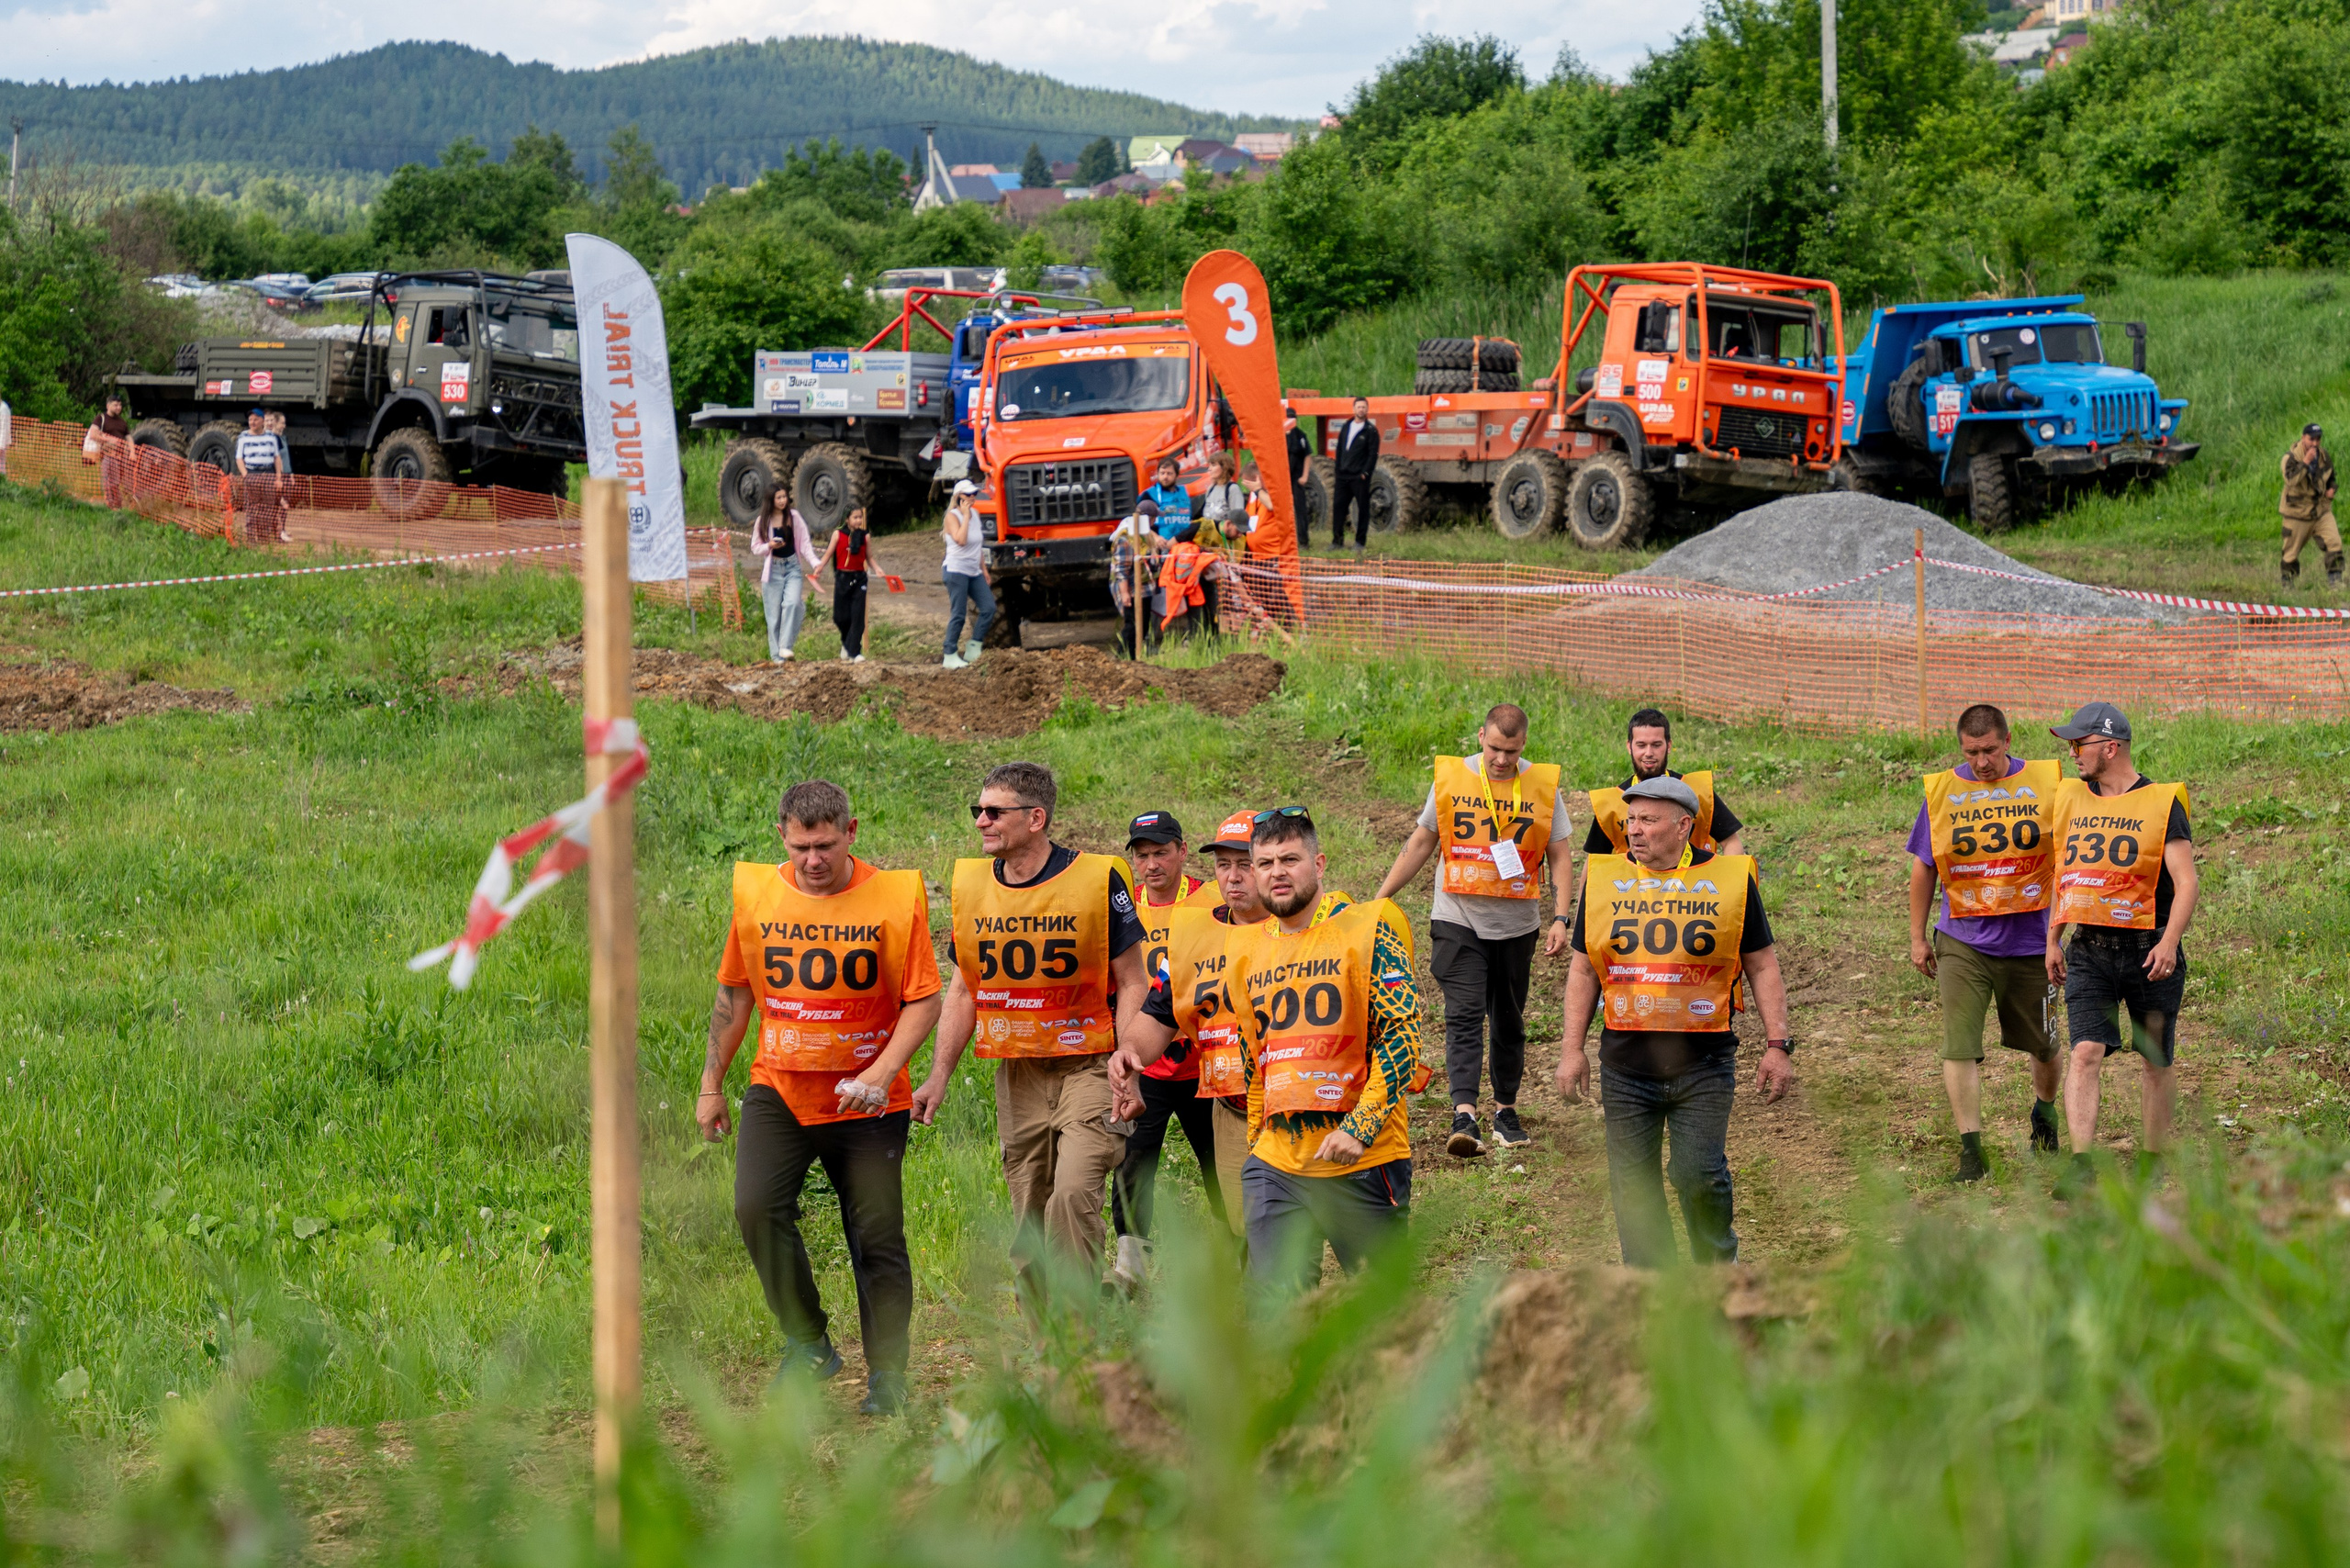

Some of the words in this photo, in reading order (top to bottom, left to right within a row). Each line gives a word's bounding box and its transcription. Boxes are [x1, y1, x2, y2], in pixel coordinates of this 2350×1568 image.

[1213, 282, 1258, 346] 3
[443, 384, 465, 398] 530
[1639, 384, 1662, 400] 500
[1732, 384, 1806, 404] УРАЛ
[1639, 402, 1674, 413] URAL
[1939, 413, 1958, 431] 517
[1039, 483, 1102, 497] УРАЛ
[1947, 786, 2037, 806] УРАЛ
[1950, 804, 2040, 824] УЧАСТНИК
[1453, 812, 1534, 845] 517
[2068, 816, 2144, 832] УЧАСТНИК
[1952, 819, 2041, 857] 530
[2064, 833, 2139, 867] 530
[1984, 866, 2017, 877] РУБЕЖ
[1612, 879, 1719, 894] УРАЛ
[1611, 901, 1719, 916] УЧАСТНИК
[2098, 896, 2143, 908] УРАЛ
[760, 923, 881, 942] УЧАСТНИК
[975, 916, 1078, 934] УЧАСТНИК
[1610, 918, 1716, 957] 506
[979, 938, 1079, 980] 505
[765, 946, 878, 991] 500
[1247, 958, 1341, 993] УЧАСТНИК
[1641, 973, 1683, 982] РУБЕЖ
[1004, 999, 1045, 1009] РУБЕЖ
[1251, 982, 1342, 1040] 500
[797, 1010, 845, 1020] РУБЕЖ
[1040, 1017, 1096, 1030] УРАЛ
[836, 1029, 890, 1043] УРАЛ
[855, 1047, 878, 1055] SINTEC
[1297, 1070, 1355, 1082] УРАЛ
